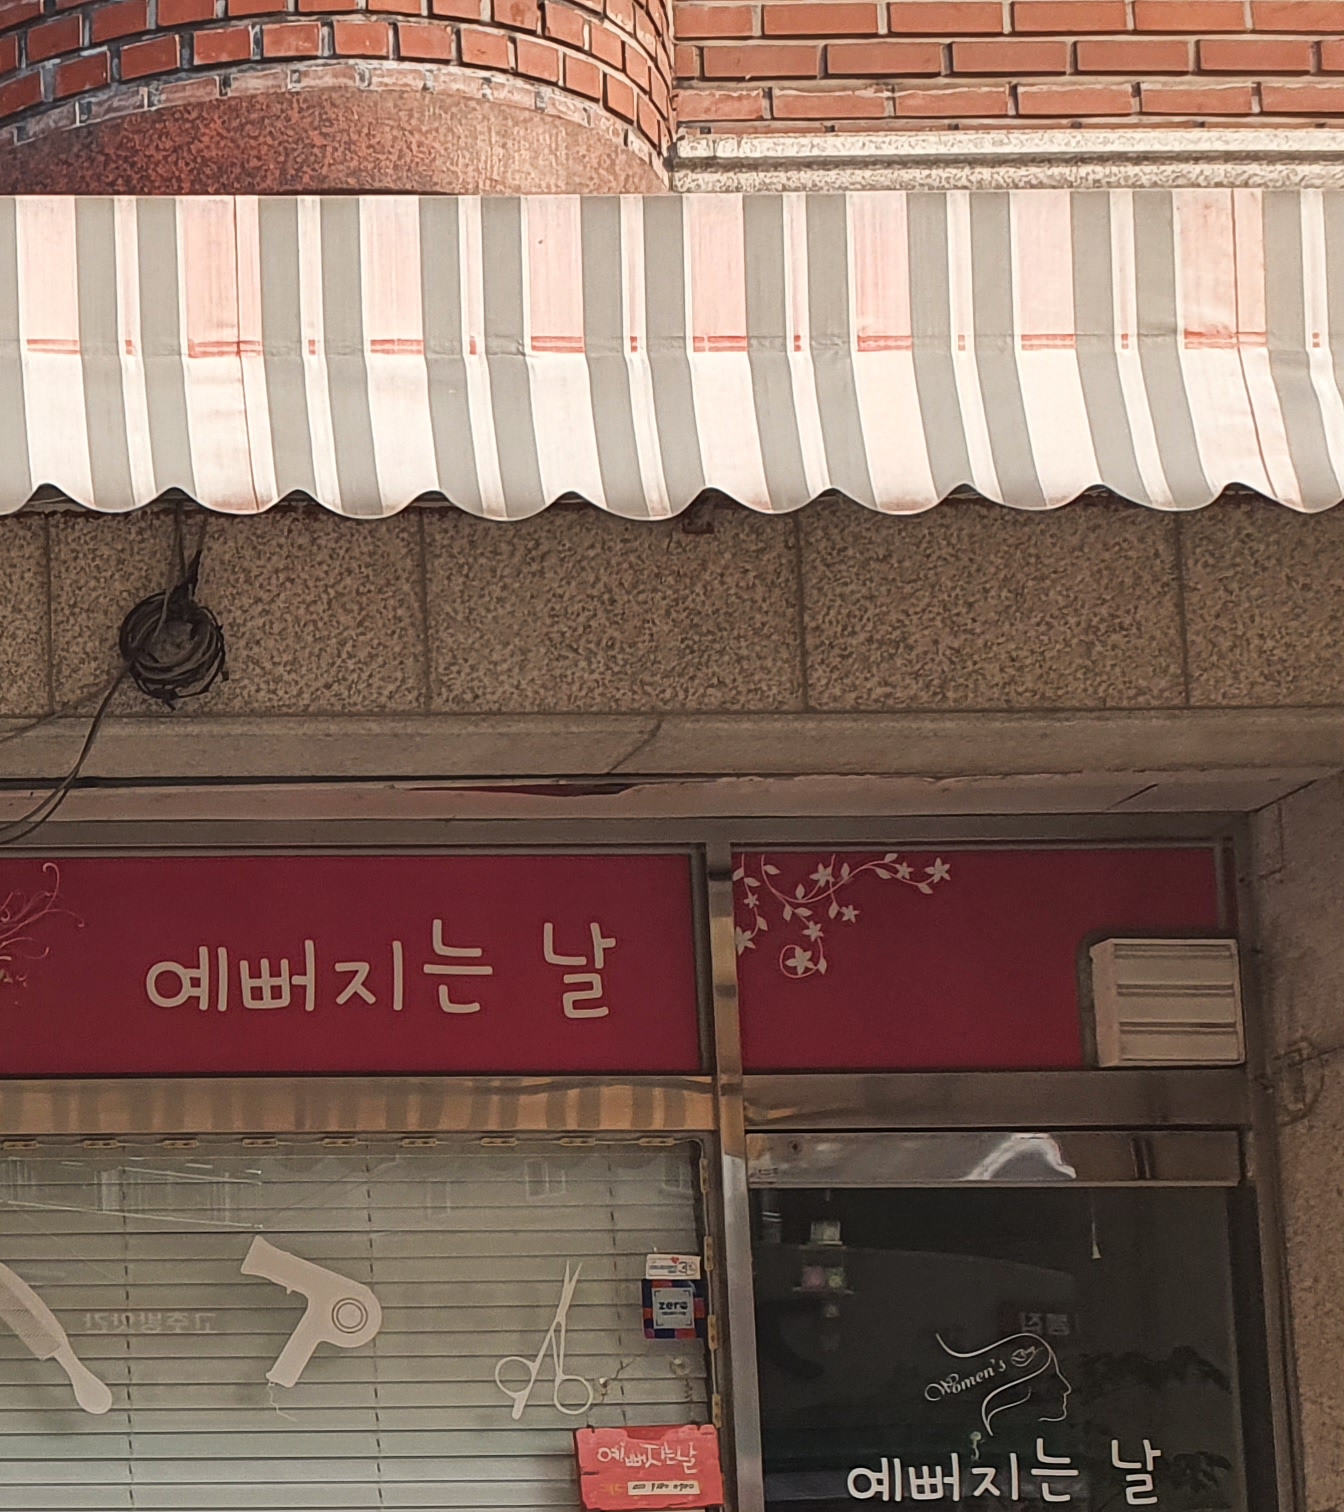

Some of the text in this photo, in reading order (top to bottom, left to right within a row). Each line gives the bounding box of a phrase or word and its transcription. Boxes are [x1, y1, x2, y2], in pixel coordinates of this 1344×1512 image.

[145, 918, 618, 1020] 예뻐지는 날
[924, 1358, 1007, 1401] Women's
[846, 1437, 1162, 1506] 예뻐지는 날
